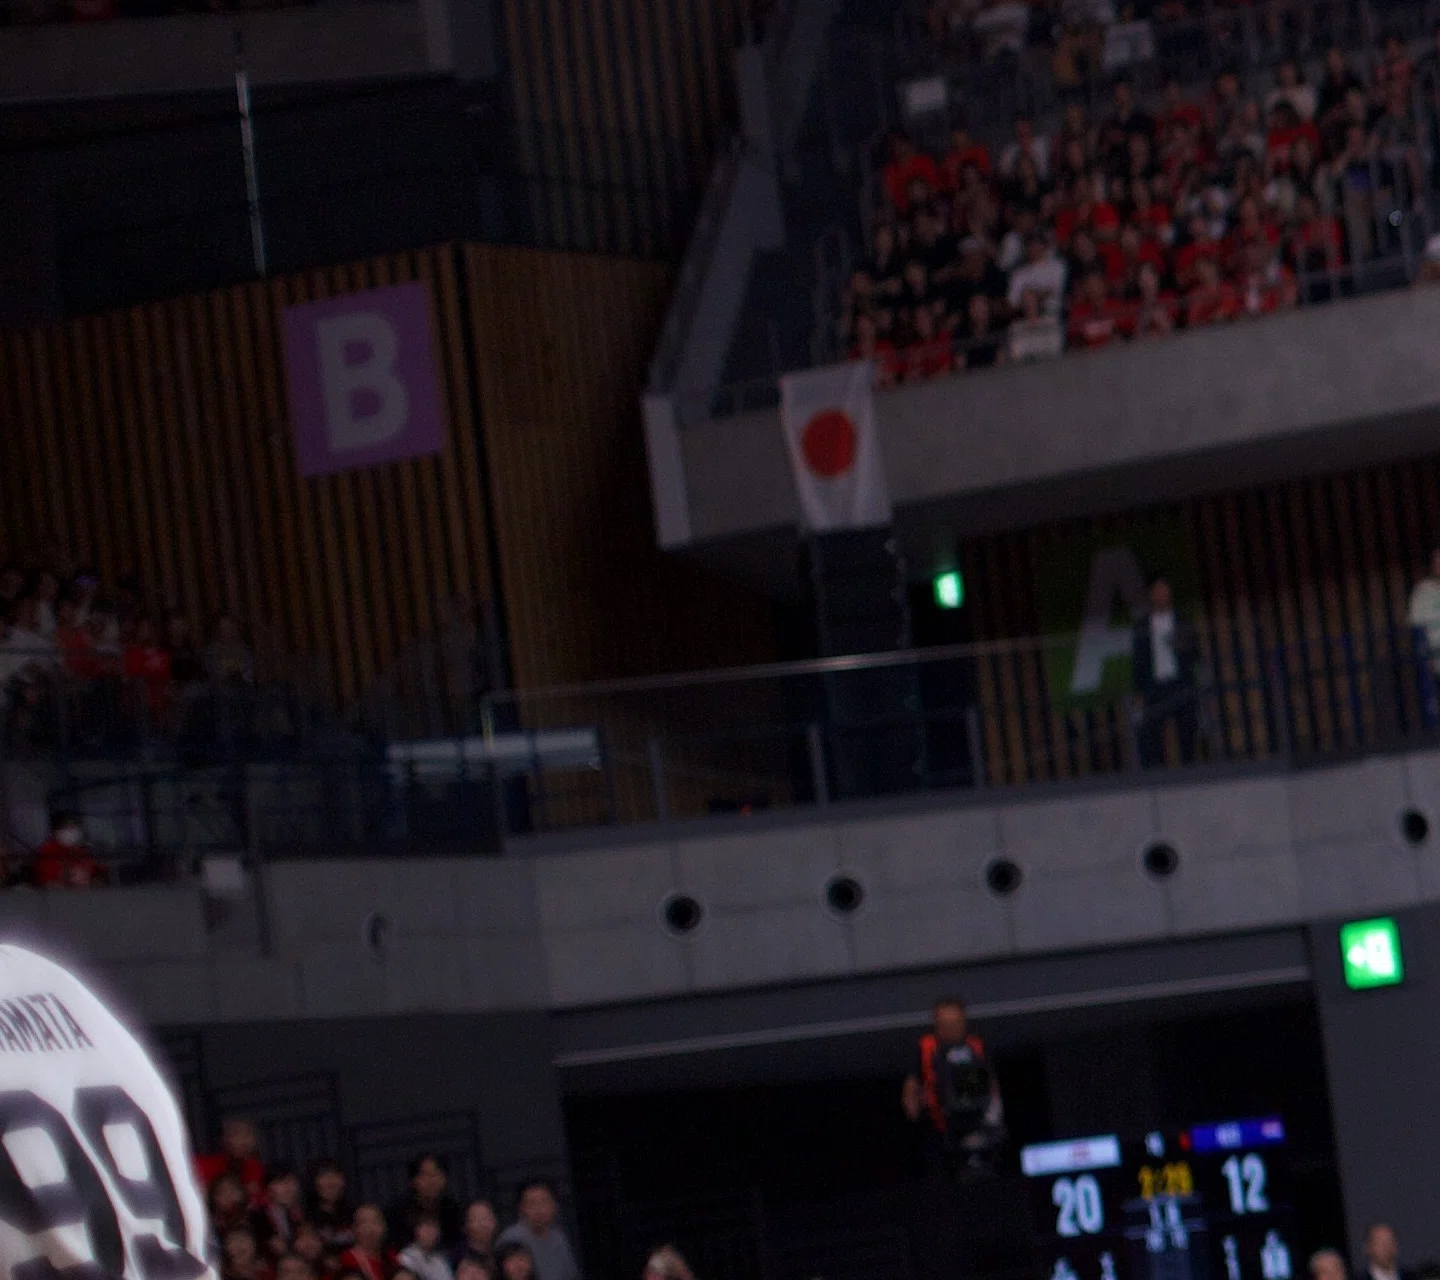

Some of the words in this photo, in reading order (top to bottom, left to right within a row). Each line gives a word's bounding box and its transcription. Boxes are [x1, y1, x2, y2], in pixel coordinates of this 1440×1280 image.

[315, 311, 410, 451] B
[1052, 1174, 1104, 1238] 20
[1222, 1152, 1270, 1215] 12
